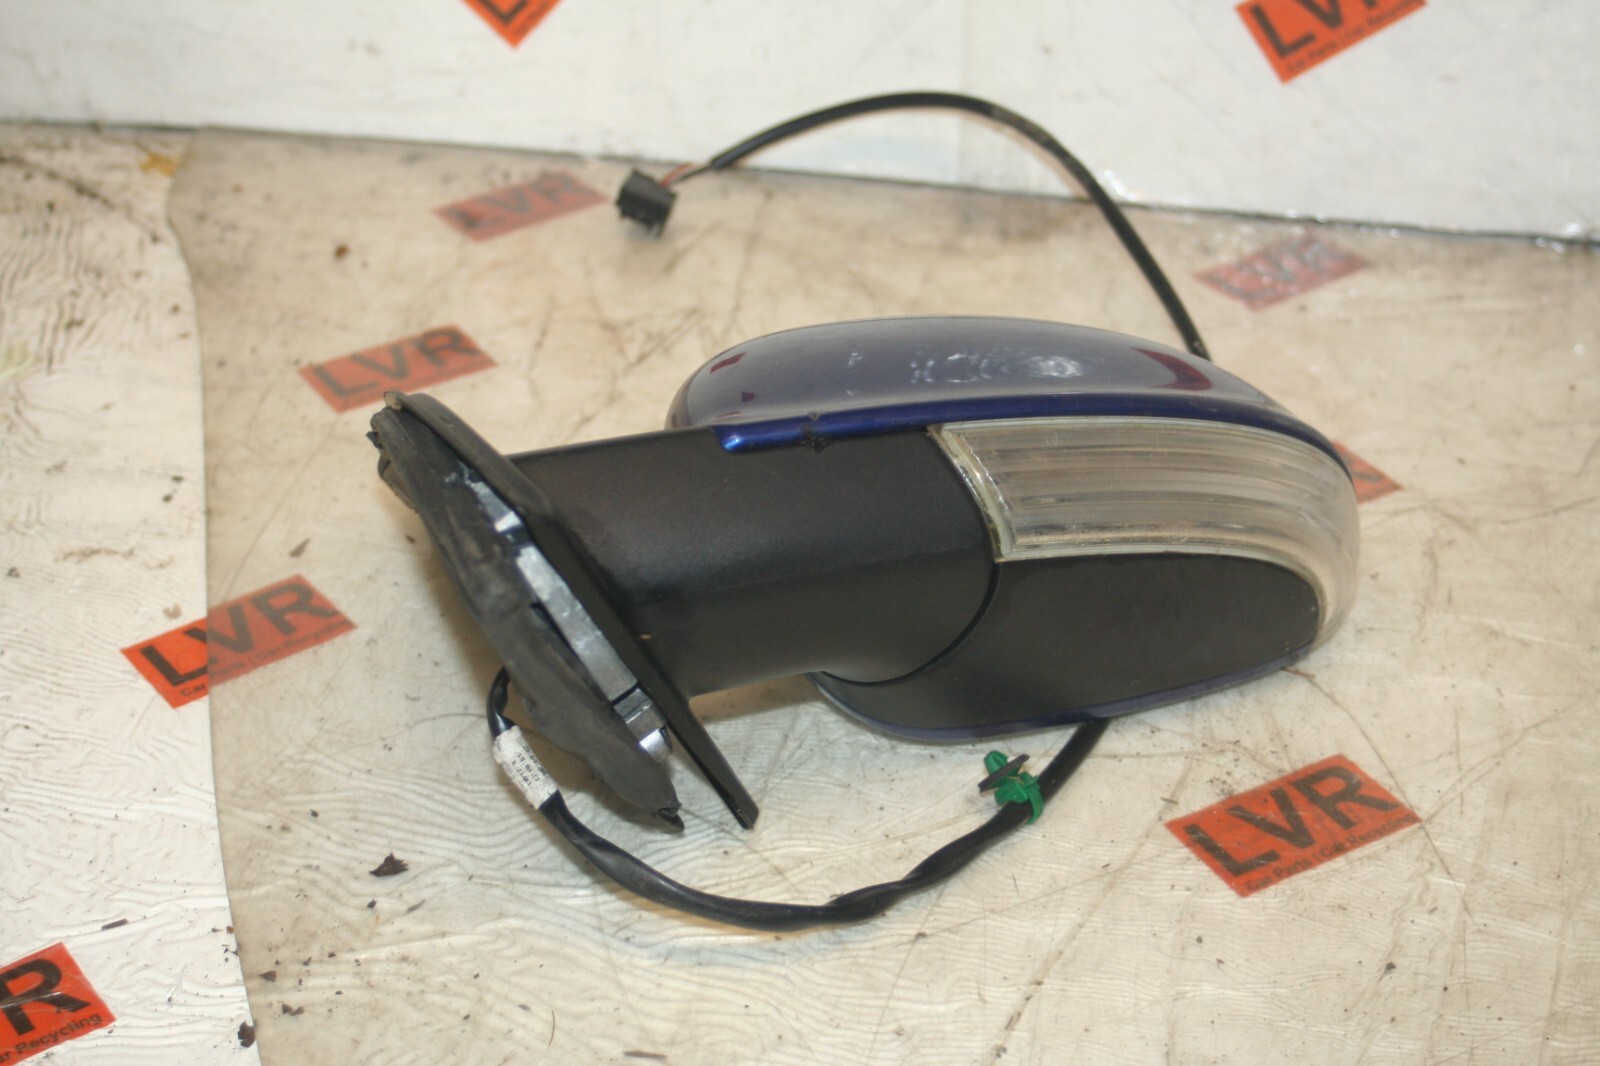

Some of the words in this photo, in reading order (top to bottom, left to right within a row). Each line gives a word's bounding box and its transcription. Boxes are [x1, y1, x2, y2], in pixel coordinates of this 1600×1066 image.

[1252, 0, 1377, 57] LV
[447, 171, 600, 230] LVR
[314, 329, 480, 396] LVR
[139, 583, 341, 687] LVR
[1183, 765, 1400, 877] LVR
[15, 1013, 102, 1055] Recycling
